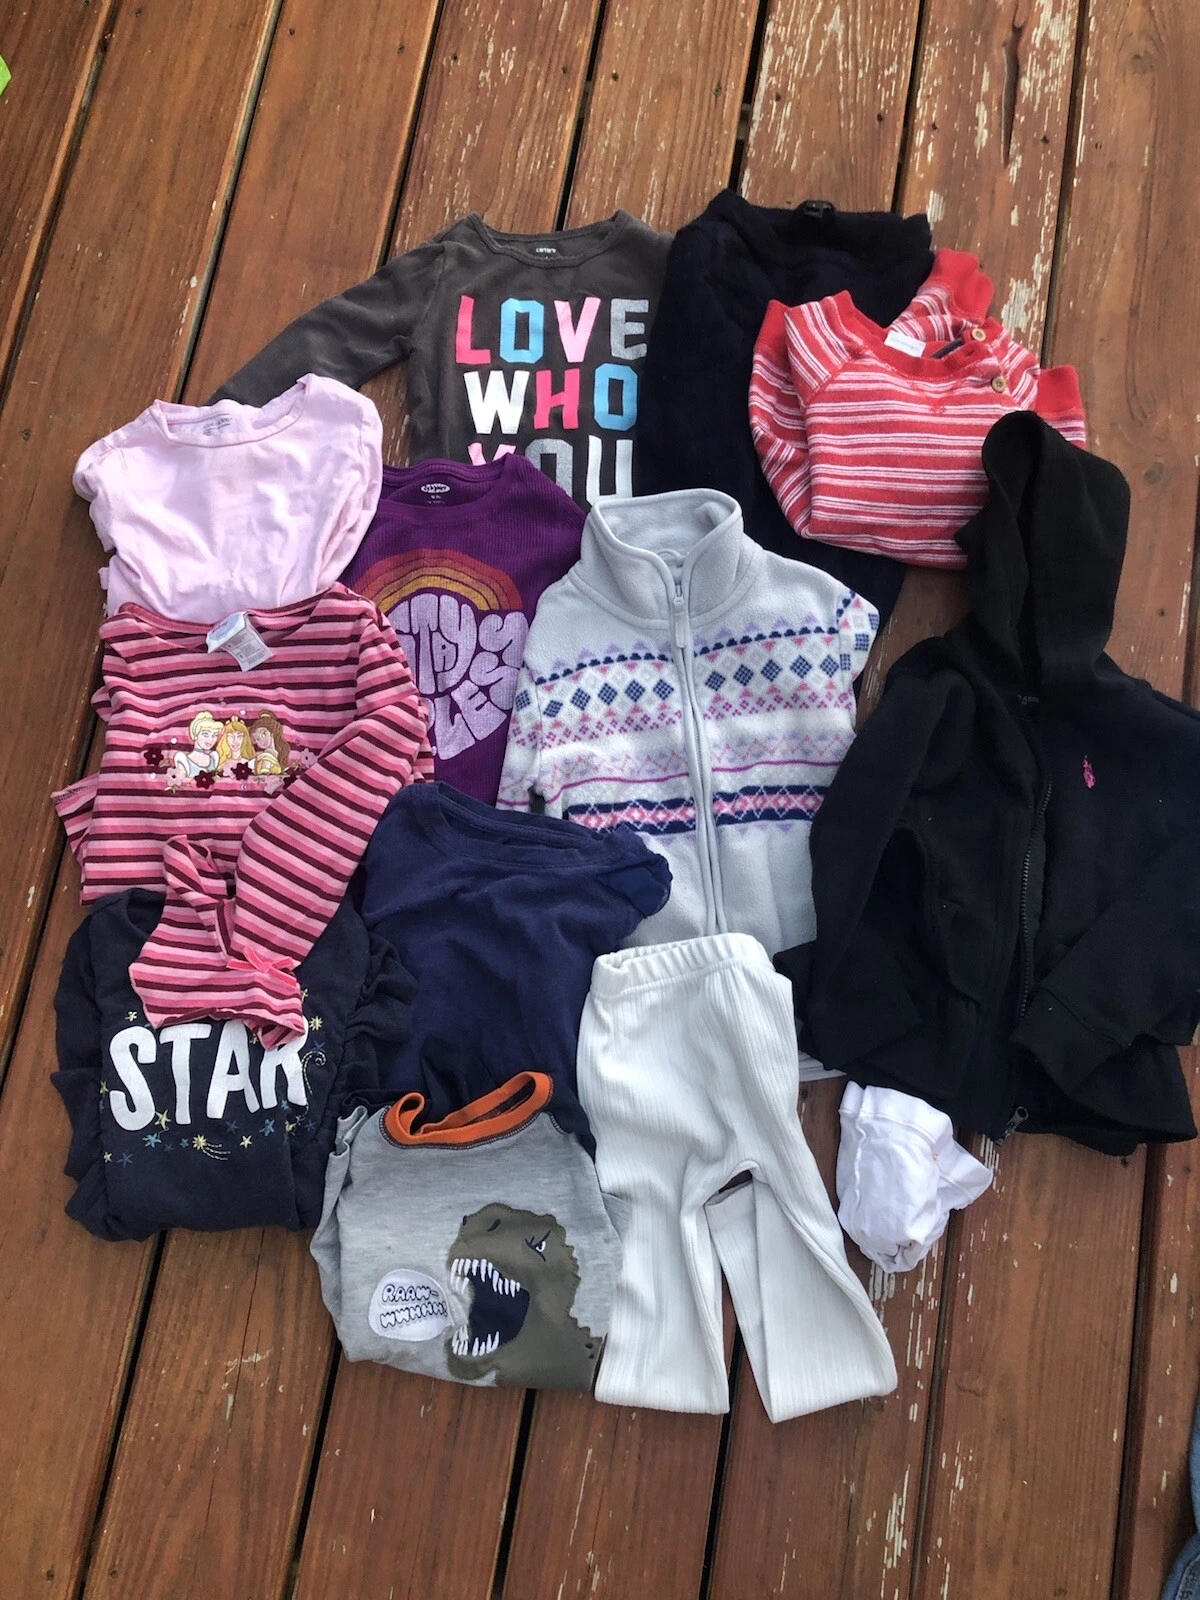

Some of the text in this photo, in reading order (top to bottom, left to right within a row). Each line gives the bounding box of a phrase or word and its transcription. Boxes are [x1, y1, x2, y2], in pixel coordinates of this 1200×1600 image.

[455, 295, 649, 363] LOVE
[463, 363, 638, 434] WHO
[109, 1016, 308, 1131] STAR
